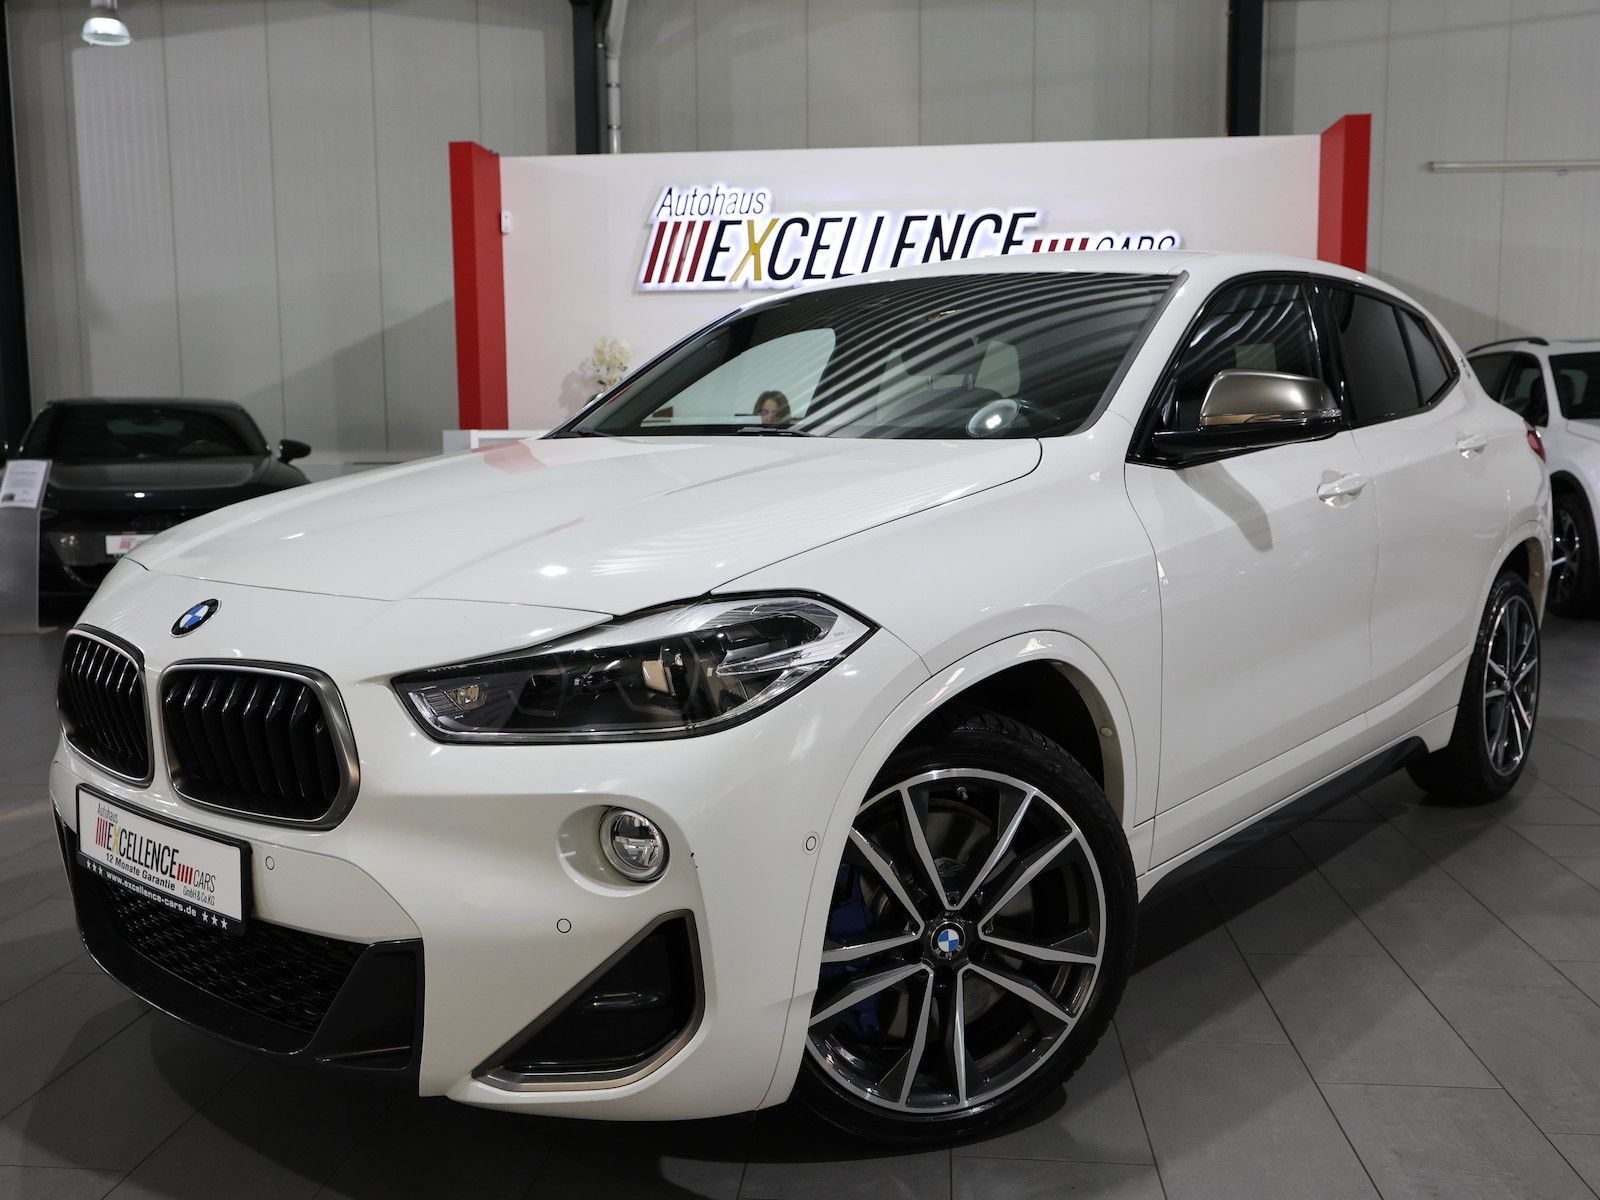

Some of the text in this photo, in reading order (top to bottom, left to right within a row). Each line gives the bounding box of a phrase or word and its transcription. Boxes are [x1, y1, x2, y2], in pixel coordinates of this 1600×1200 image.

[656, 186, 766, 217] Autohaus
[704, 212, 1036, 282] EXCELLENCE
[106, 822, 216, 893] EXCELLENCE CARS
[106, 853, 175, 891] 12 Monate Garantie
[106, 871, 197, 917] www.excellence-cars.de
